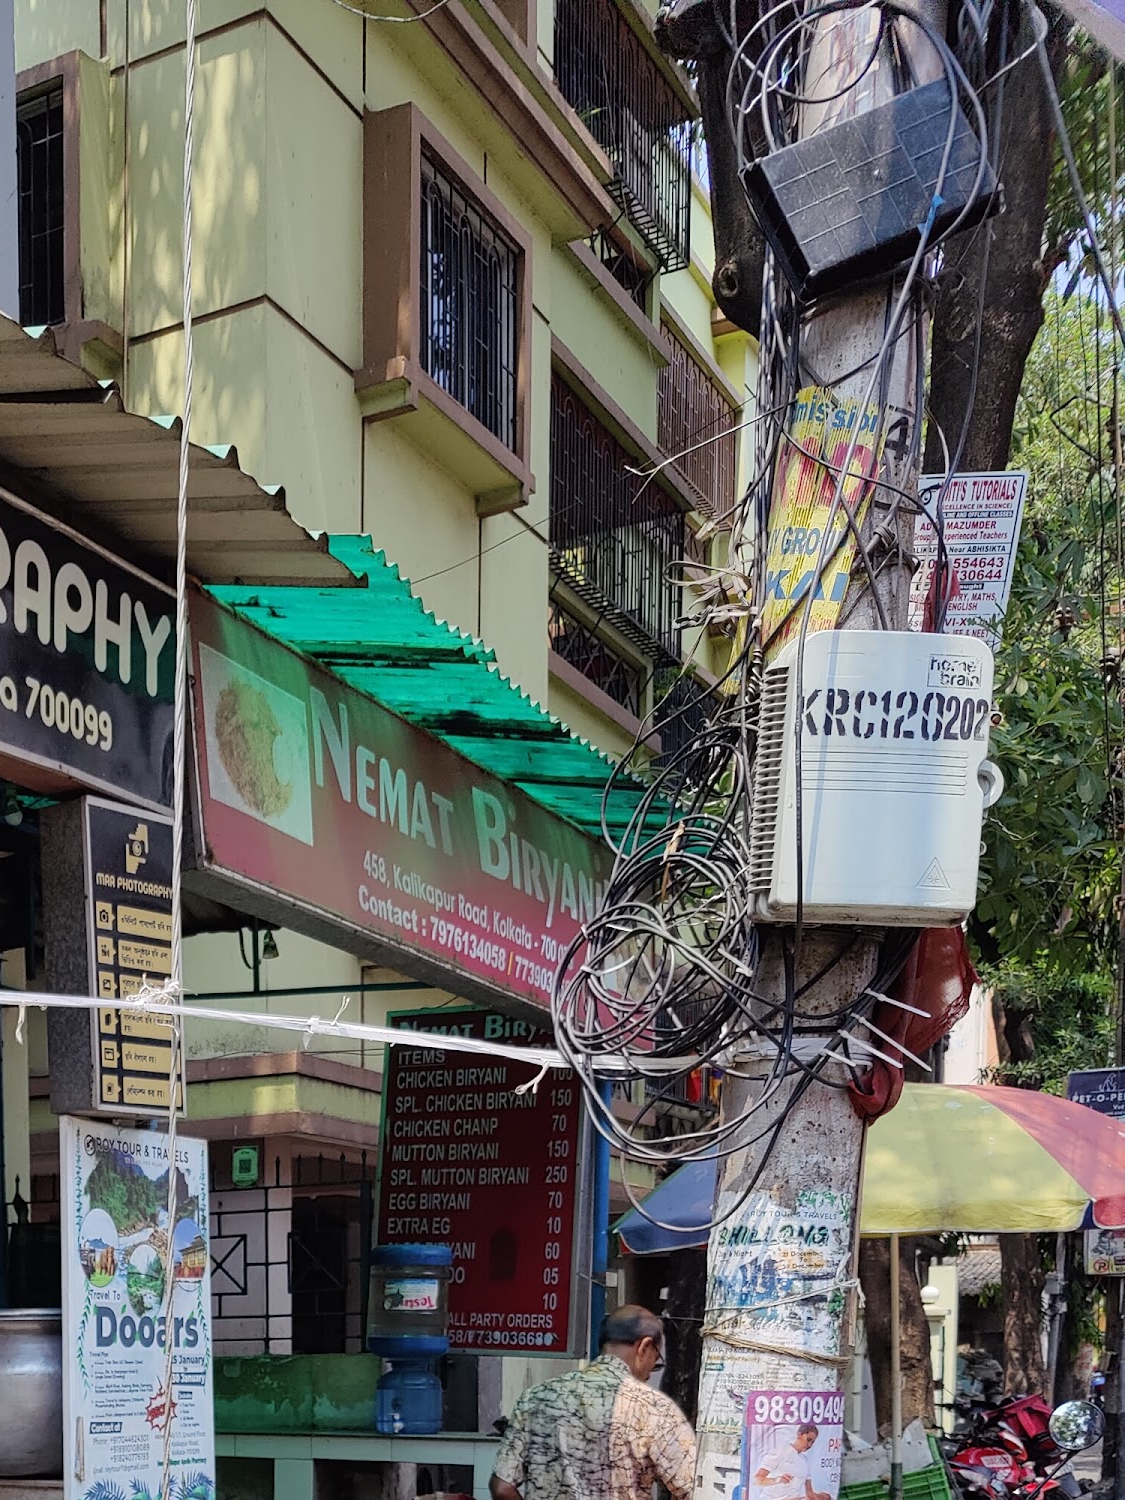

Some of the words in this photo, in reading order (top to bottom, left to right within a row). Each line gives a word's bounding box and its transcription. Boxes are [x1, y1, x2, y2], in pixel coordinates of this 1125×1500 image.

[971, 480, 1018, 501] TUTORIALS
[946, 521, 997, 530] MAZUMDER
[967, 545, 1006, 553] ABHISIKTA
[25, 677, 112, 751] 700099
[96, 872, 115, 888] MAA
[117, 876, 173, 900] PHOTOGRAPHY
[362, 851, 388, 884] 458,
[393, 865, 455, 915] Kalikapur
[458, 893, 491, 933] Road,
[493, 913, 533, 949] Kolkata
[358, 884, 418, 934] Contact
[430, 915, 506, 973] 7976134058
[398, 1050, 445, 1066] ITEMS
[397, 1071, 452, 1089] CHICKEN
[456, 1068, 506, 1086] BIRYANI
[395, 1097, 422, 1114] SPL.
[425, 1094, 482, 1112] CHICKEN
[486, 1091, 537, 1110] BIRYANI
[550, 1089, 572, 1107] 150
[394, 1120, 450, 1137] CHICKEN
[453, 1118, 499, 1136] CHANP
[552, 1116, 566, 1131] 70
[392, 1144, 444, 1161] MUTTON
[448, 1143, 498, 1161] BIRYANI
[546, 1141, 568, 1157] 150
[390, 1169, 418, 1186] SPL.
[421, 1167, 475, 1185] MUTTON
[478, 1167, 529, 1184] BIRYANI
[545, 1167, 567, 1184] 250
[389, 1193, 416, 1210] EGG
[420, 1192, 470, 1210] BIRYANI
[548, 1192, 562, 1209] 70
[387, 1217, 428, 1235] EXTRA
[431, 1217, 450, 1234] EG
[547, 1218, 561, 1234] 10
[470, 1313, 504, 1328] PARTY
[506, 1314, 553, 1328] ORDERS
